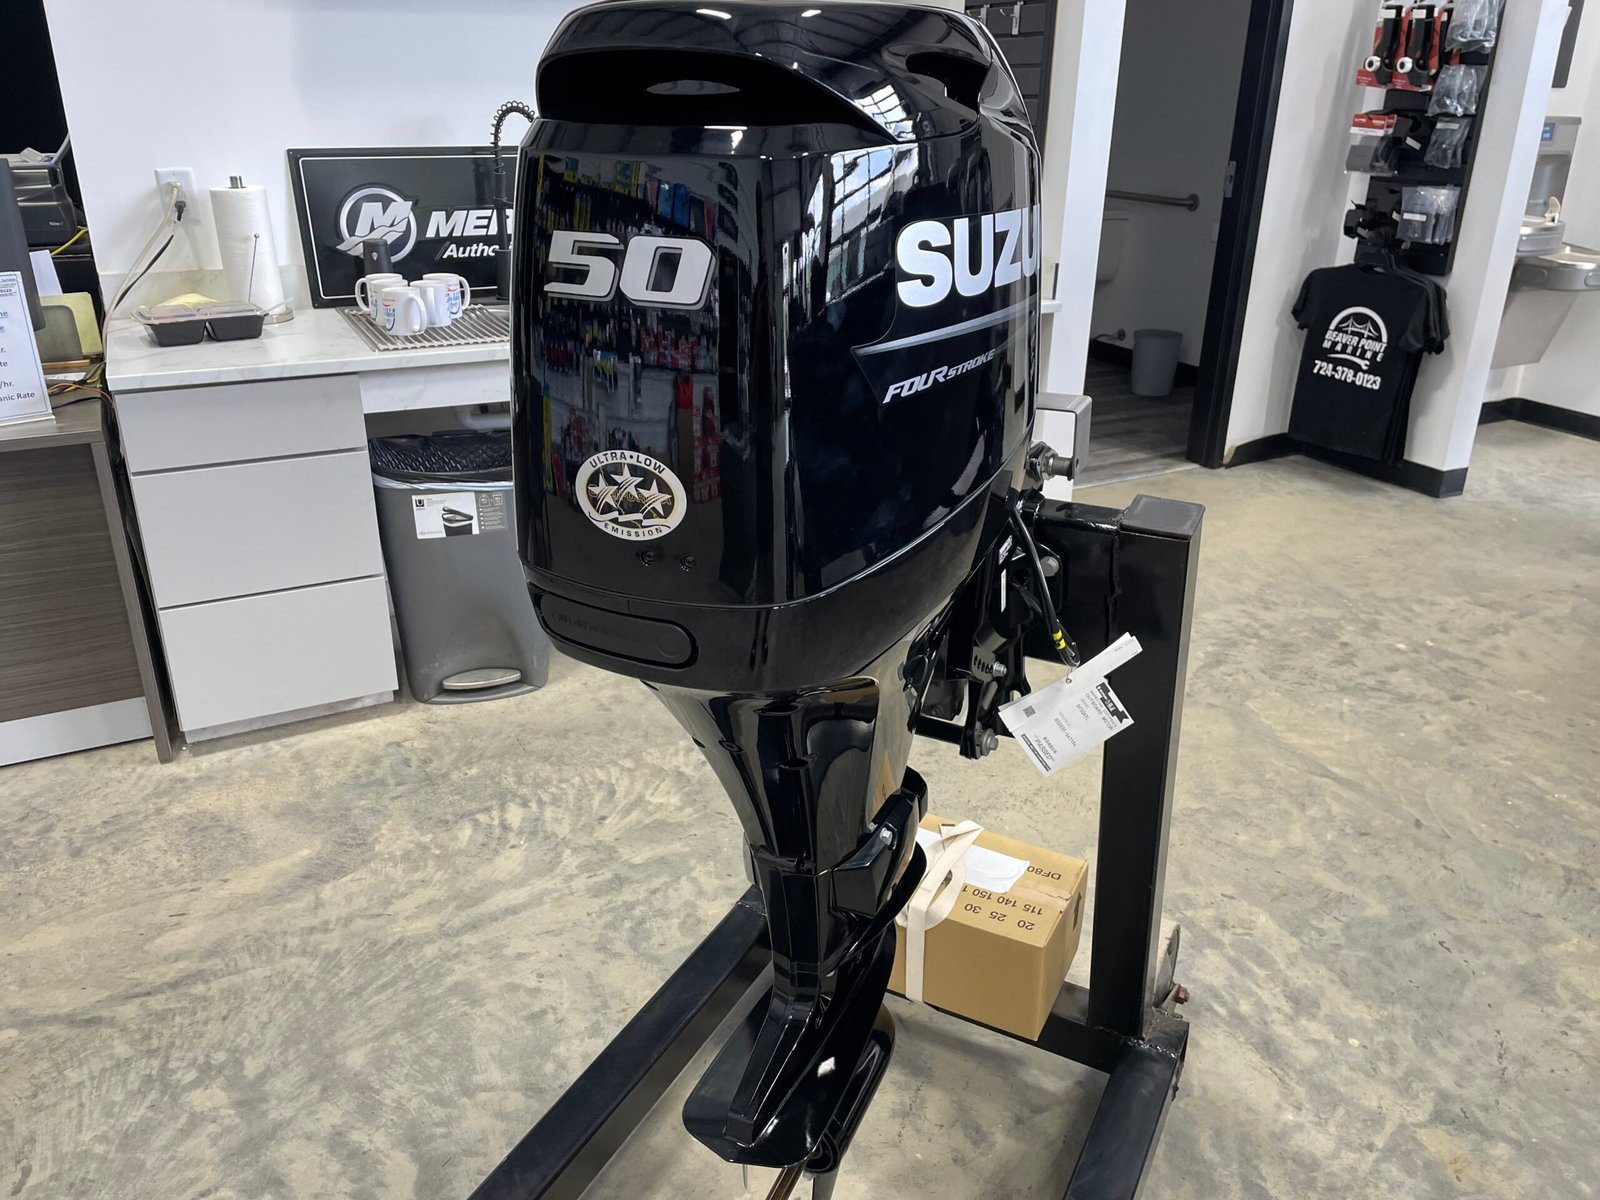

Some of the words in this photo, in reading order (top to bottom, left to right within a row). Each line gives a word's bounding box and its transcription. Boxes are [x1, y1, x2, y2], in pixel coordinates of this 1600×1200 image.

[897, 203, 1040, 307] SUZU
[544, 230, 716, 310] 50
[1325, 330, 1359, 347] BEAVER
[1359, 338, 1387, 352] POINT
[1322, 339, 1384, 362] MARINE
[1313, 359, 1382, 390] 724-378-0123
[17, 391, 35, 400] Rate
[604, 522, 663, 538] EMISSION
[1027, 865, 1062, 881] DF80
[972, 888, 992, 900] 150
[964, 903, 982, 914] 30
[997, 895, 1018, 908] 140
[989, 911, 1008, 922] 25
[1022, 904, 1042, 916] 115
[1017, 919, 1036, 931] 20
